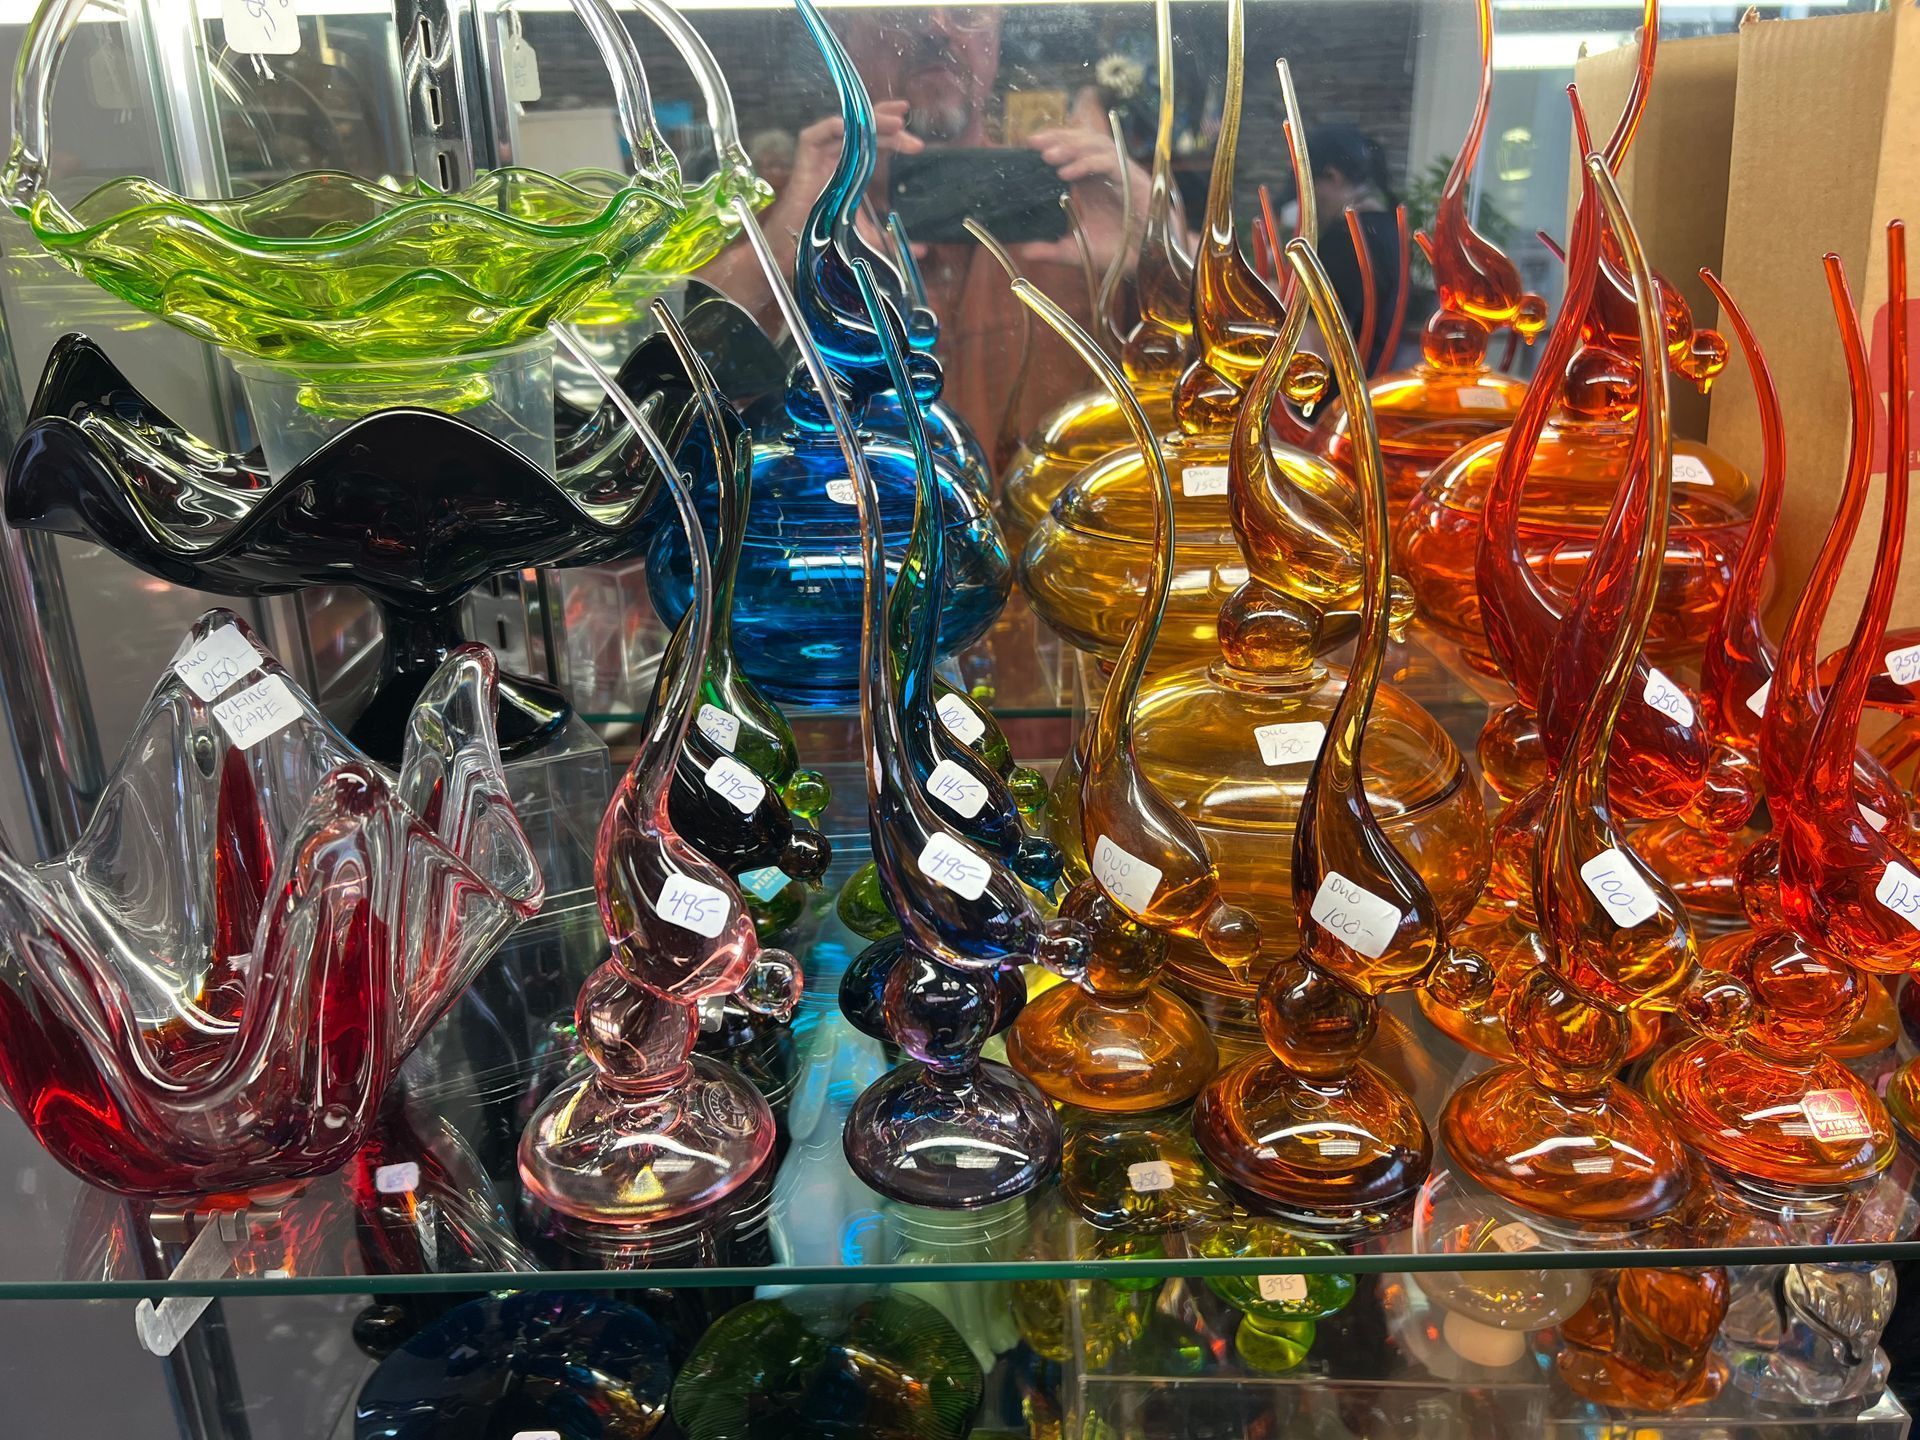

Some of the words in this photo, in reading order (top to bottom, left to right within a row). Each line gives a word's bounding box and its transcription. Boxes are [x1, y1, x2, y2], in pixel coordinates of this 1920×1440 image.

[1672, 465, 1704, 478] 50-
[201, 648, 251, 697] 250-
[215, 682, 272, 720] VIKING
[1649, 684, 1689, 713] 250-
[940, 706, 969, 732] 100-
[1273, 738, 1311, 760] 150-
[717, 771, 760, 800] 495-
[935, 775, 980, 801] 145-
[930, 849, 985, 881] 495-
[1102, 847, 1131, 877] DUO
[1103, 870, 1133, 897] 100-
[1591, 870, 1637, 917] 100-
[669, 889, 720, 922] 495-
[1321, 907, 1375, 938] 100-
